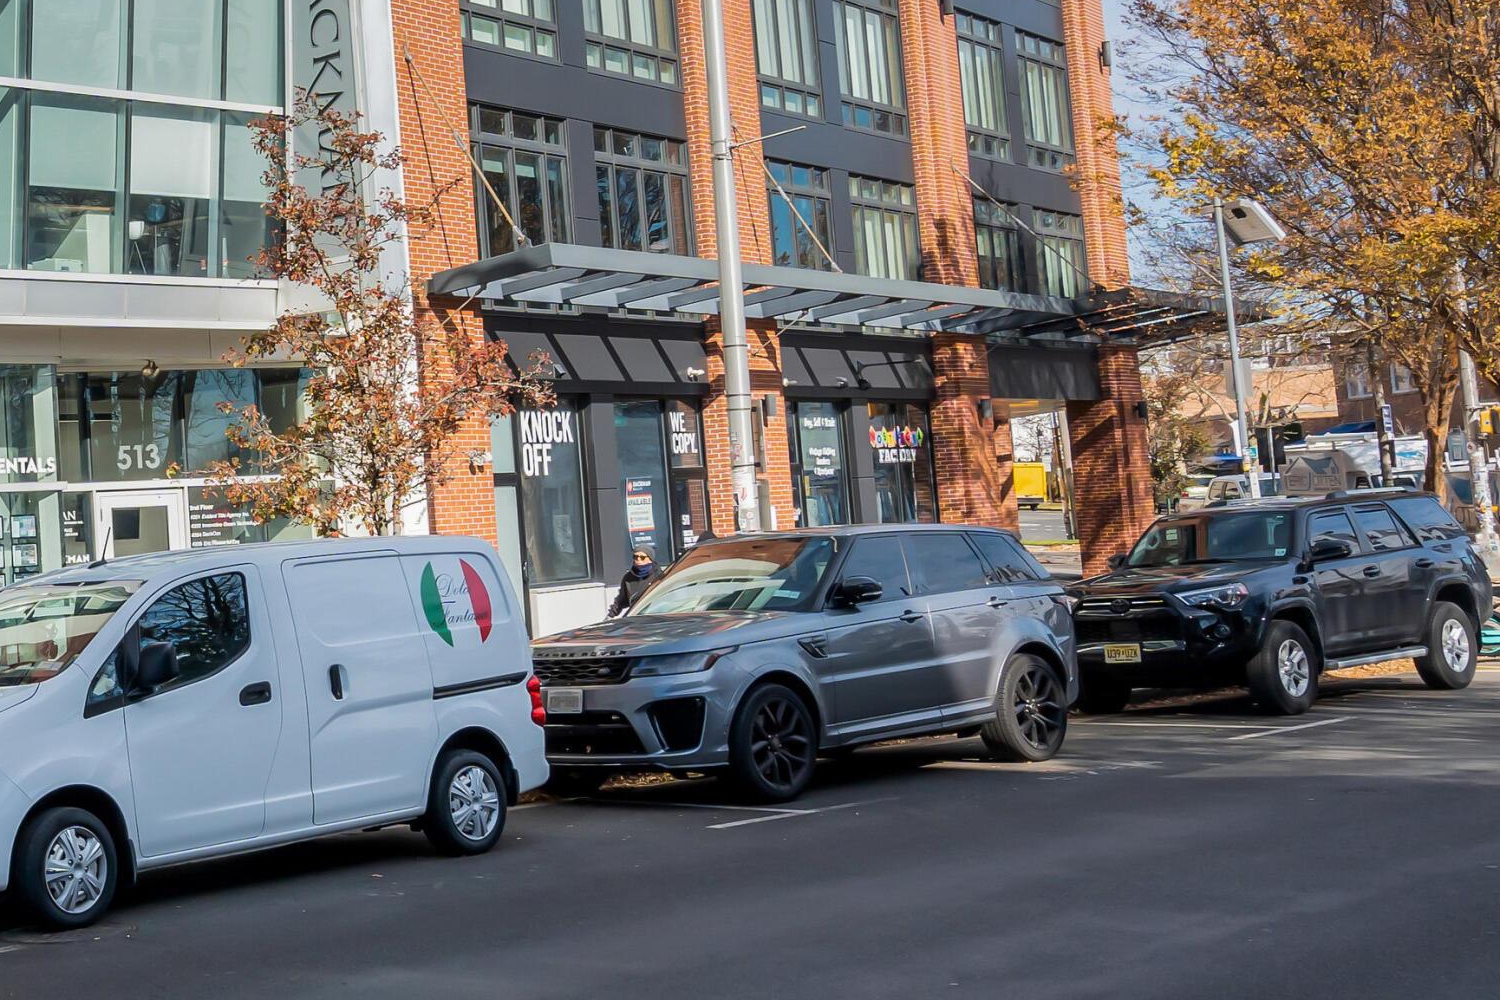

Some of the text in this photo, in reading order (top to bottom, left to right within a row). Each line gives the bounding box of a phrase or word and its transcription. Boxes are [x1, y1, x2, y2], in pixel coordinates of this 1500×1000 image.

[520, 411, 574, 443] KNOCK
[669, 412, 685, 432] WE
[672, 432, 698, 454] COPY.
[117, 444, 161, 470] 513
[523, 443, 553, 476] OFF
[878, 448, 917, 463] FACORY
